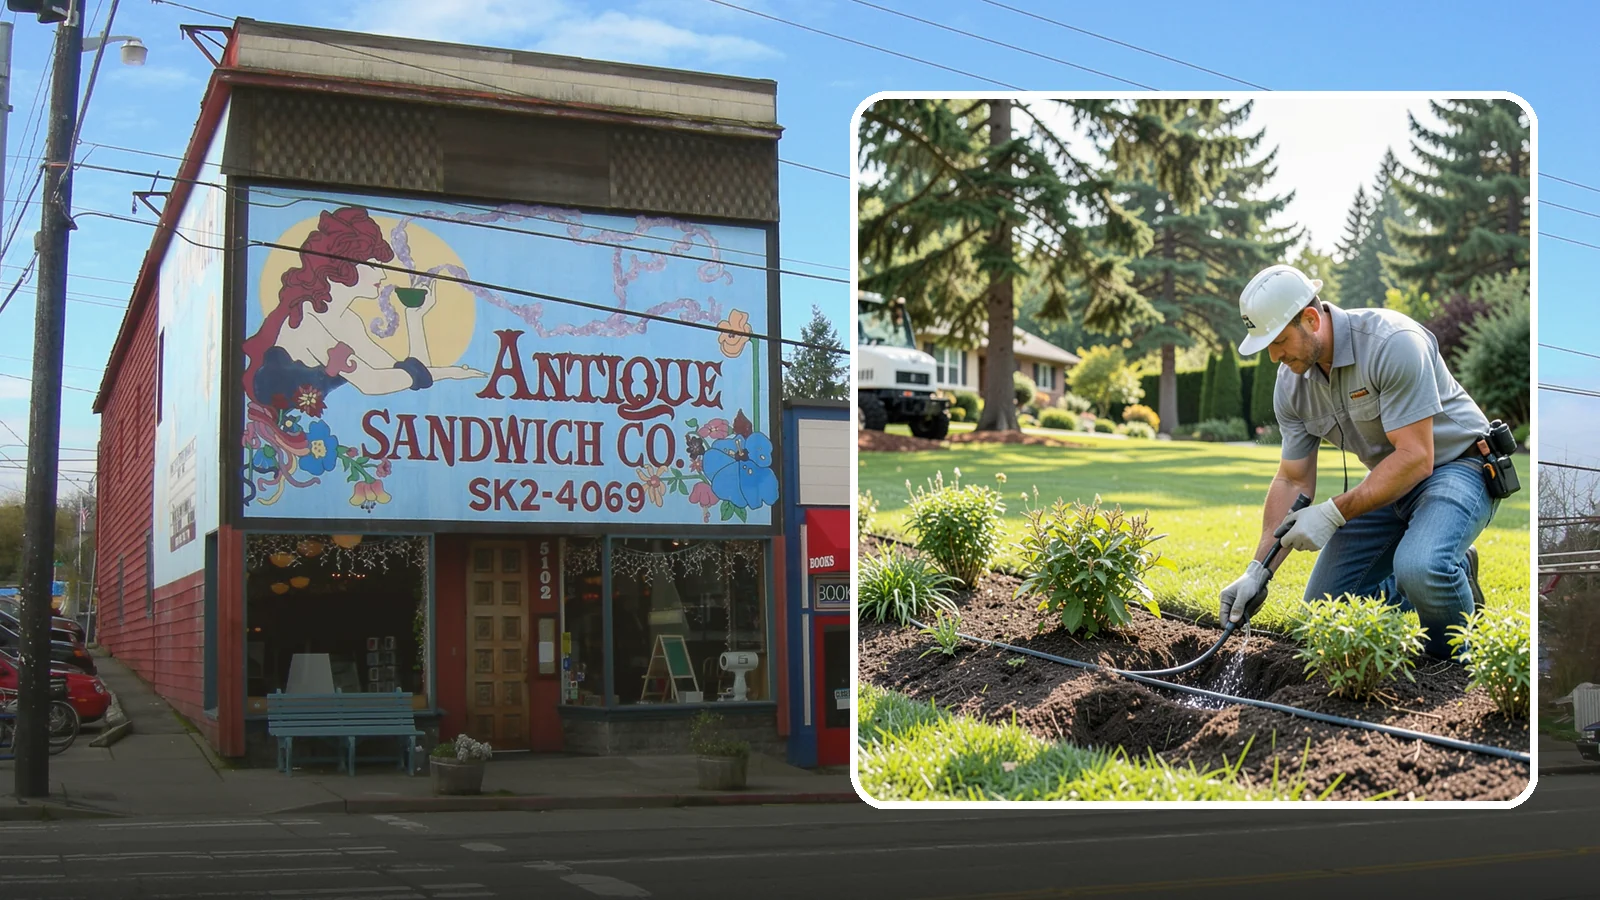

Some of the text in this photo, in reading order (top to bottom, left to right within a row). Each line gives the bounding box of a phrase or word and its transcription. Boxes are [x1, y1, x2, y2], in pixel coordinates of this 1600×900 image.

[475, 329, 724, 420] ANTIQUE
[361, 408, 685, 469] SANDWICH CO.
[468, 477, 645, 513] SK2-4069
[539, 542, 552, 600] 5102
[809, 555, 835, 569] BOOKS
